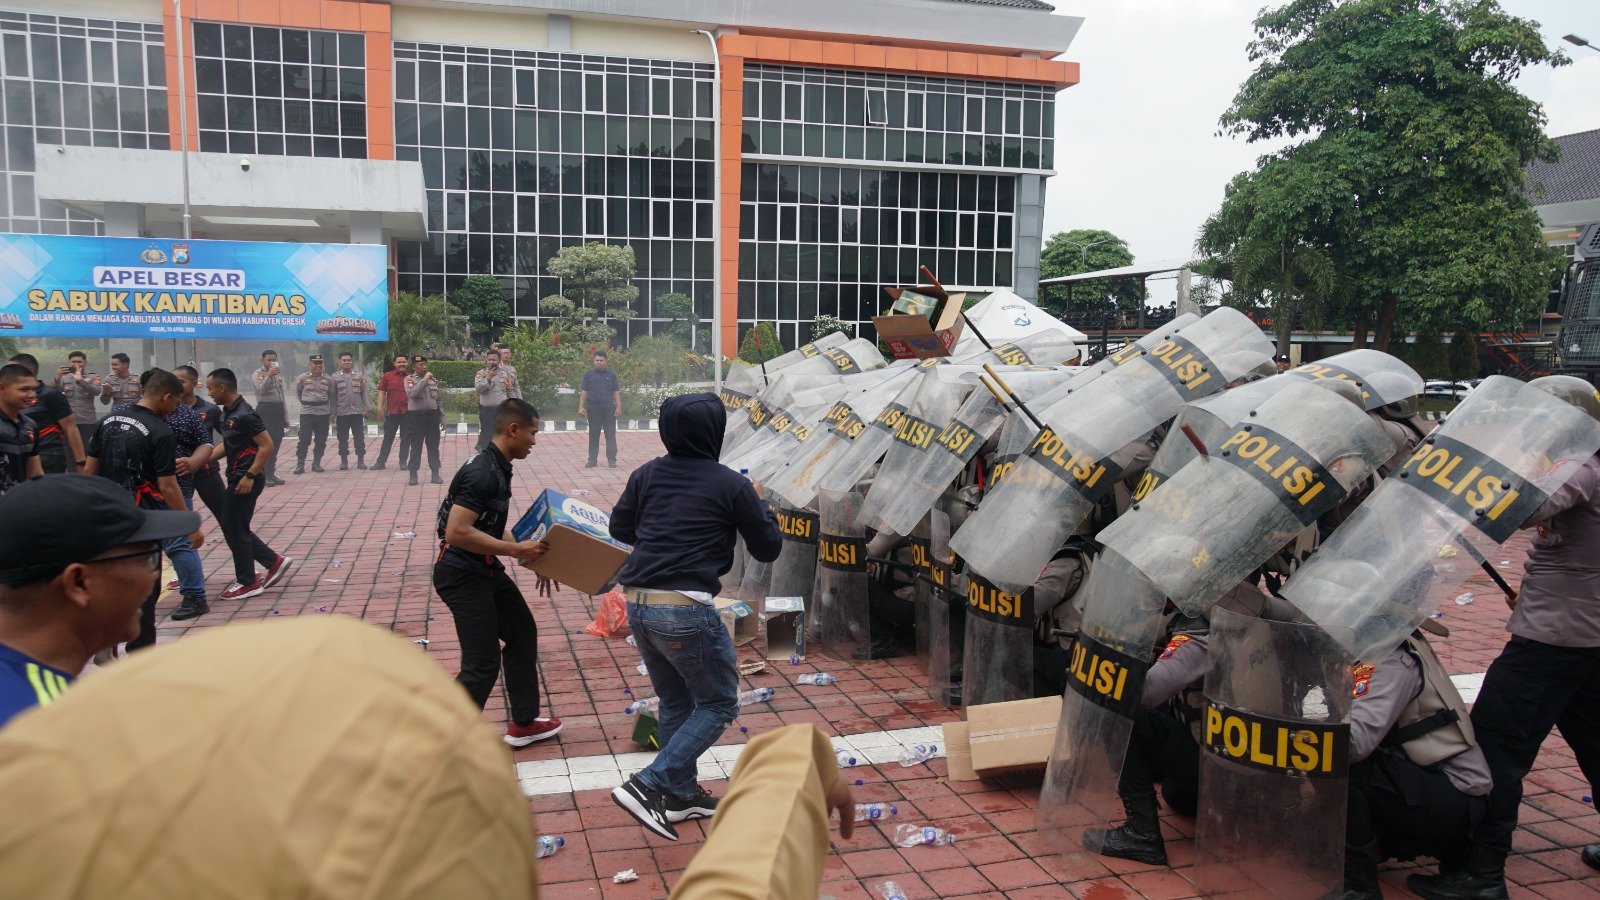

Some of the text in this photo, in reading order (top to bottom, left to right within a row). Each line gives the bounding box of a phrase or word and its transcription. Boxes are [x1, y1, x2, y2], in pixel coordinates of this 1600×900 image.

[100, 270, 240, 287] APEL BESAR
[28, 289, 306, 315] SABUK KAMTIBMAS
[30, 313, 54, 322] DALAM
[56, 314, 85, 322] RANGKA
[87, 315, 120, 323] MENJAGA
[122, 315, 160, 324] STABILITAS
[162, 316, 201, 324] KAMTIBMAS
[212, 317, 240, 325] WILAYAH
[242, 317, 280, 325] KABUPATEN
[282, 318, 306, 326] GRESIK
[1151, 339, 1212, 391] OLISI
[896, 418, 936, 449] LISI
[936, 419, 976, 455] LISI
[1032, 428, 1107, 489] POLISI
[1220, 430, 1326, 506] POLISI
[1402, 443, 1521, 521] POLISI
[570, 504, 610, 530] AQUA
[820, 539, 856, 565] OLISI
[966, 578, 1022, 618] OLISI
[1070, 641, 1129, 701] OLISI
[1207, 705, 1335, 773] POLISI
